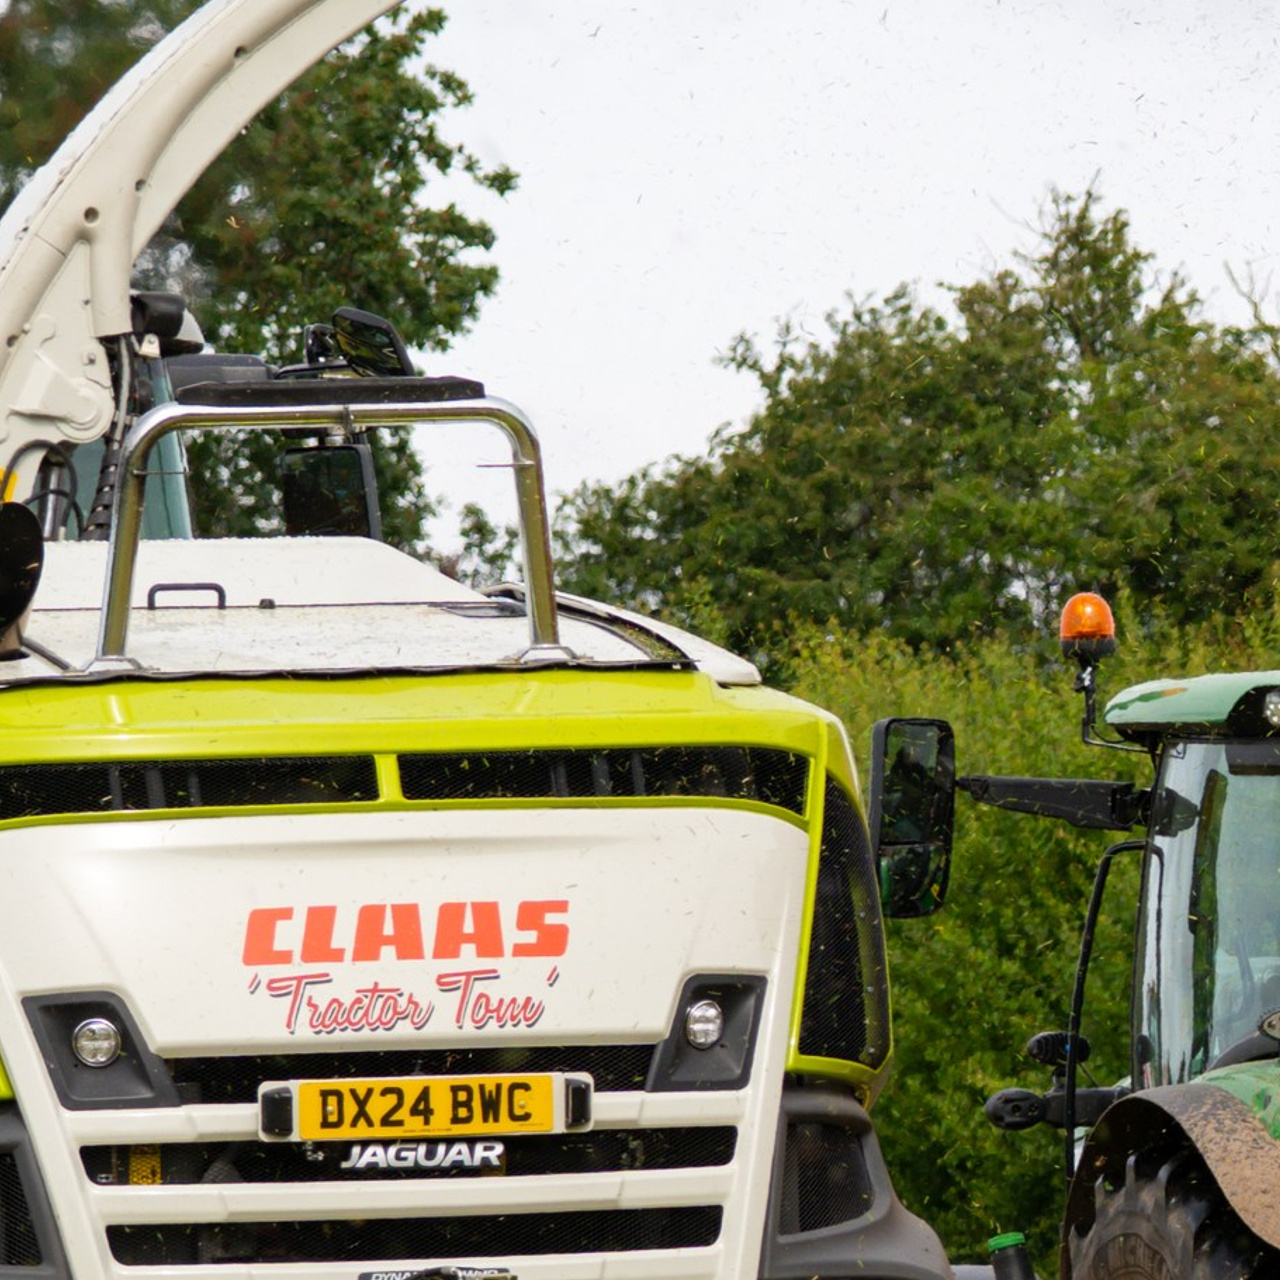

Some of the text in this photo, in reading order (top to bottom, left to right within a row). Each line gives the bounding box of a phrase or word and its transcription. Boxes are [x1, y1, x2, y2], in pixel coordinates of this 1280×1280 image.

[242, 900, 569, 966] CLAAS
[319, 1082, 532, 1129] DX24 BWC
[341, 1141, 505, 1168] JAGUAR
